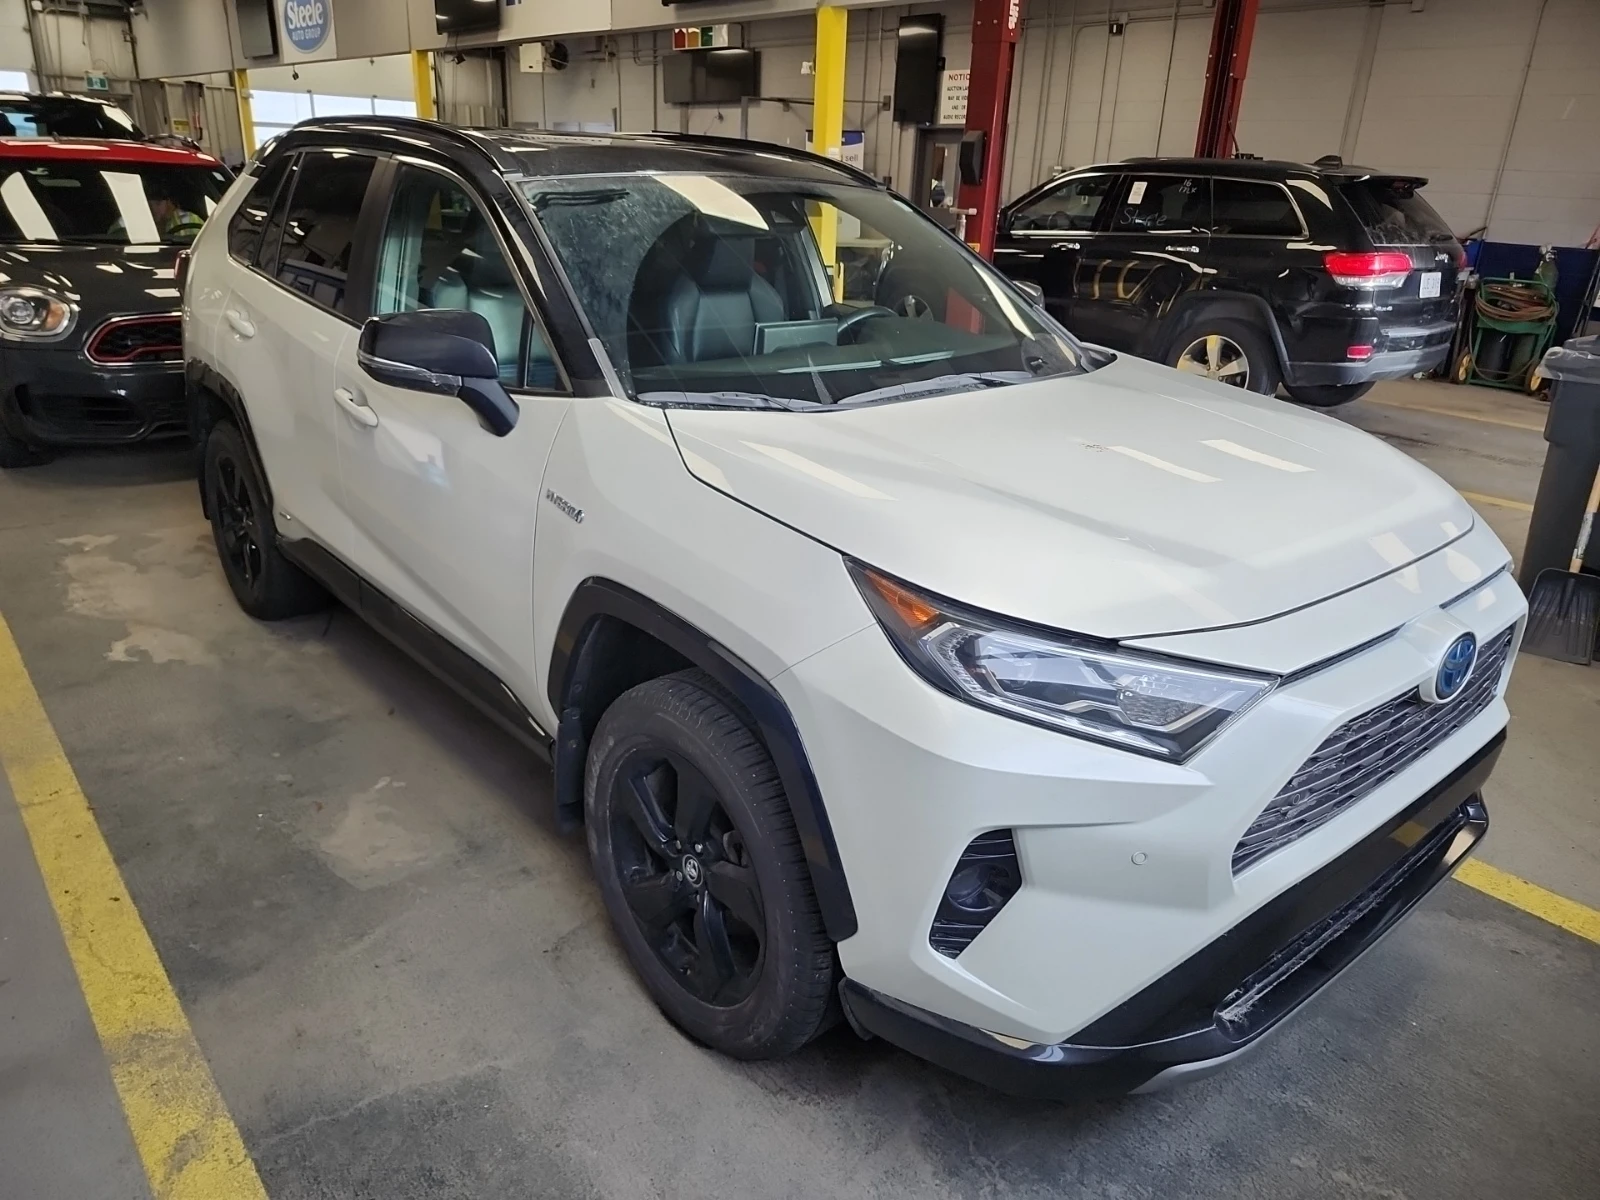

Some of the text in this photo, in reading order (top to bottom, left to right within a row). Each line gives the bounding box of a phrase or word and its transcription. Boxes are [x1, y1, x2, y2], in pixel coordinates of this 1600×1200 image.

[287, 0, 324, 29] Steele
[292, 27, 321, 41] AUTO GROUP
[845, 154, 859, 162] sell
[1183, 179, 1192, 187] 16
